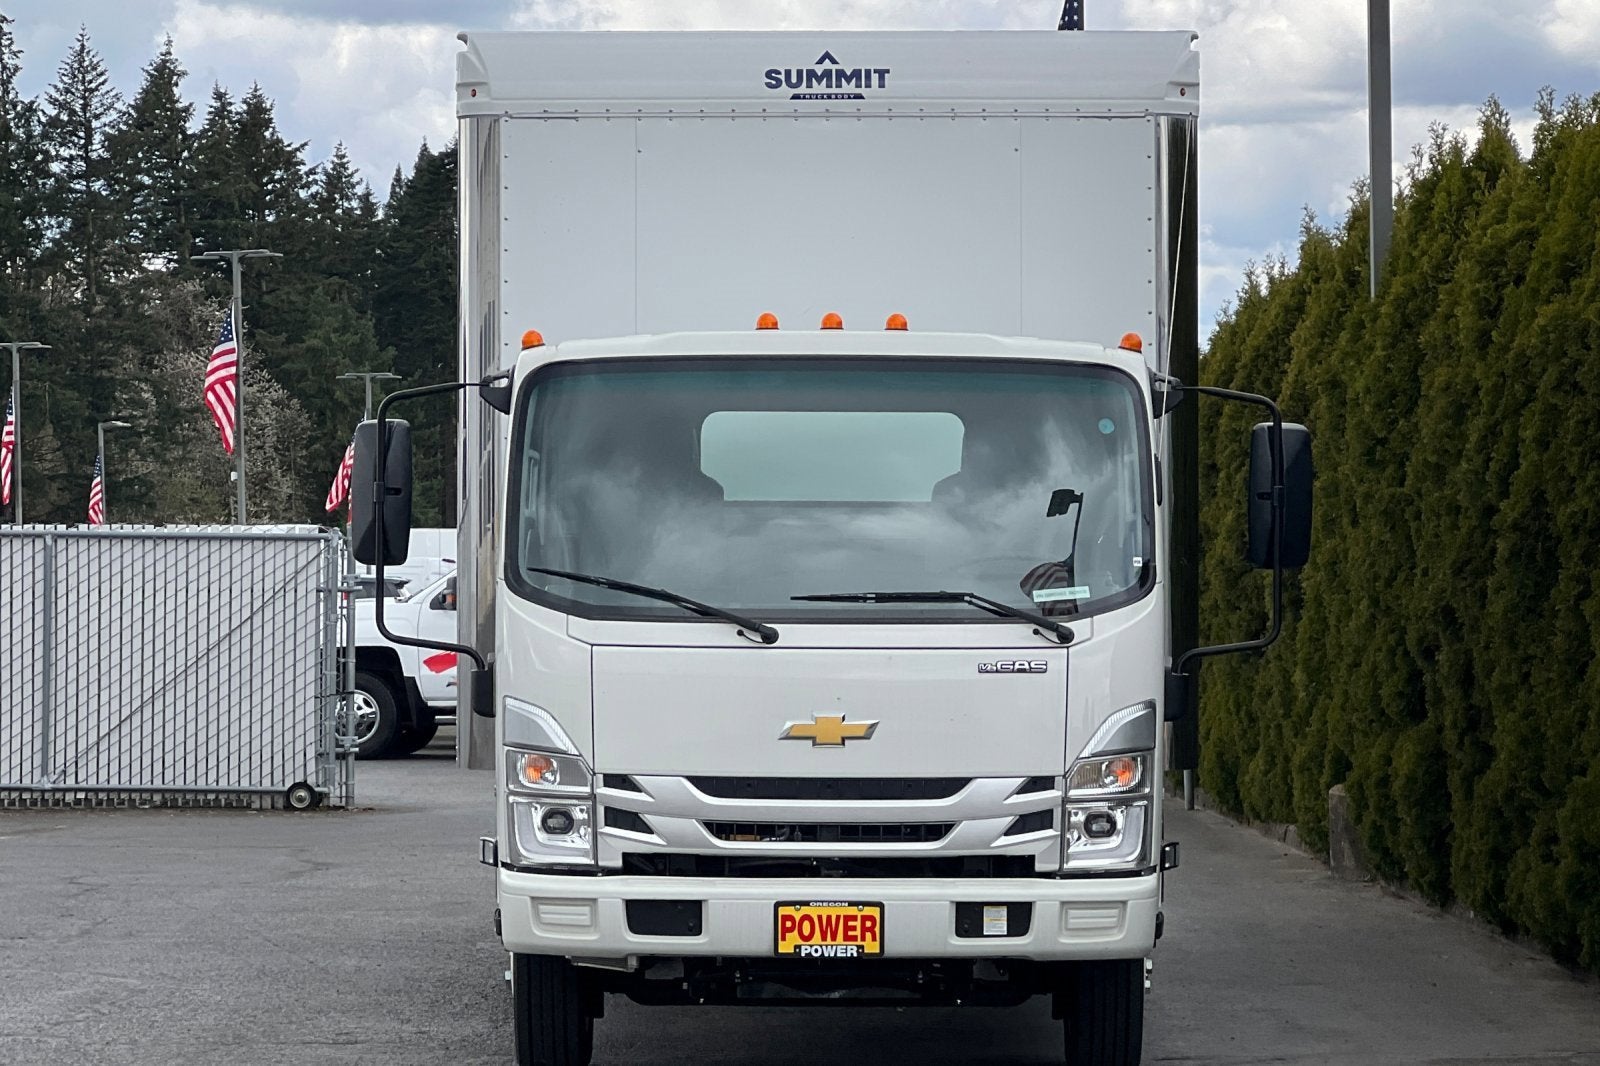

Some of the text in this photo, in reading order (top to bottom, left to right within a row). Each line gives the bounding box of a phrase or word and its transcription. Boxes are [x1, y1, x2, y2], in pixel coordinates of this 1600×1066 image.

[764, 68, 890, 89] SUMMIT
[996, 660, 1047, 673] GAS
[780, 914, 878, 942] POWER
[801, 945, 858, 957] POWER
